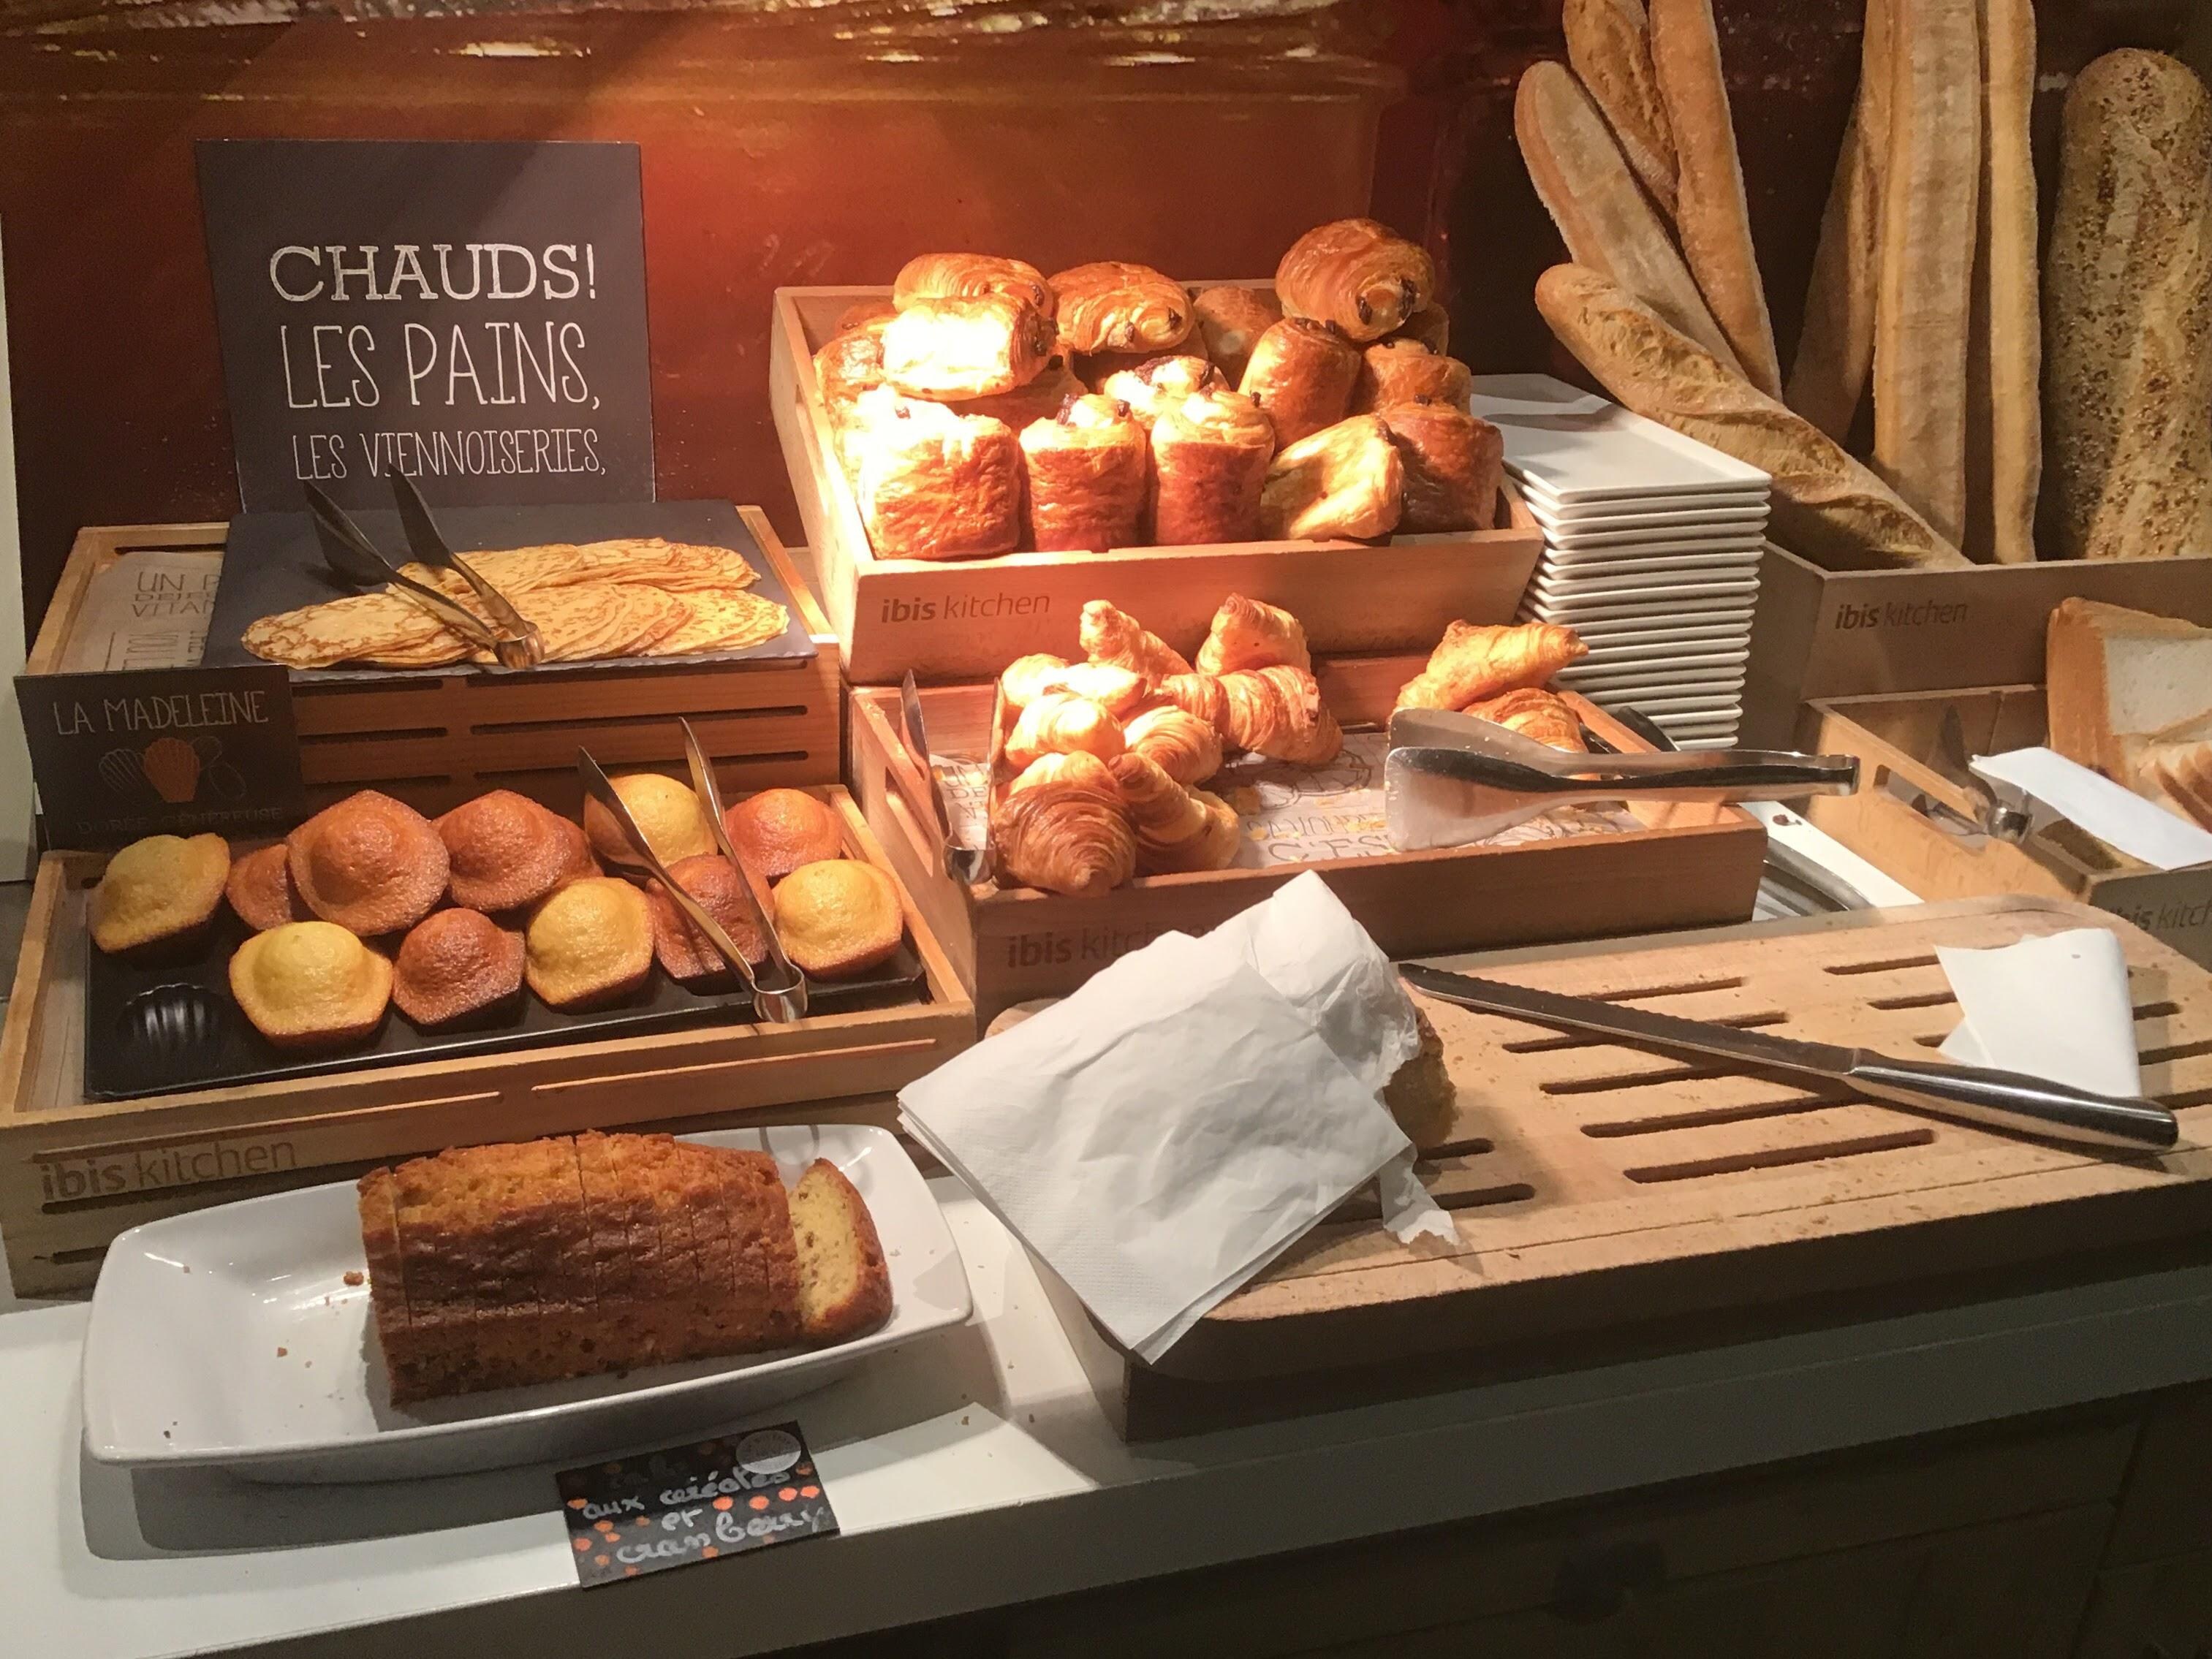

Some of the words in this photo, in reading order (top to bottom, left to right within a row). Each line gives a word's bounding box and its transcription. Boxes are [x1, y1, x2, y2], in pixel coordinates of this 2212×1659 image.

[270, 243, 596, 302] CHAUDS!
[280, 324, 380, 409] LES
[404, 321, 600, 409] PAINS,
[292, 433, 347, 480] LES
[360, 428, 606, 478] VIENNOISERIES,
[137, 572, 186, 593] UN
[881, 596, 936, 623] ibis
[944, 592, 1050, 620] kitchen
[1835, 603, 1880, 629] ibis
[1884, 599, 1969, 626] kitchen
[53, 702, 95, 735] LA
[103, 690, 269, 732] MADELEINE
[1007, 931, 1072, 968] ibis
[41, 1158, 127, 1201] ibis
[137, 1139, 298, 1188] kitchen
[583, 1495, 645, 1520] aux
